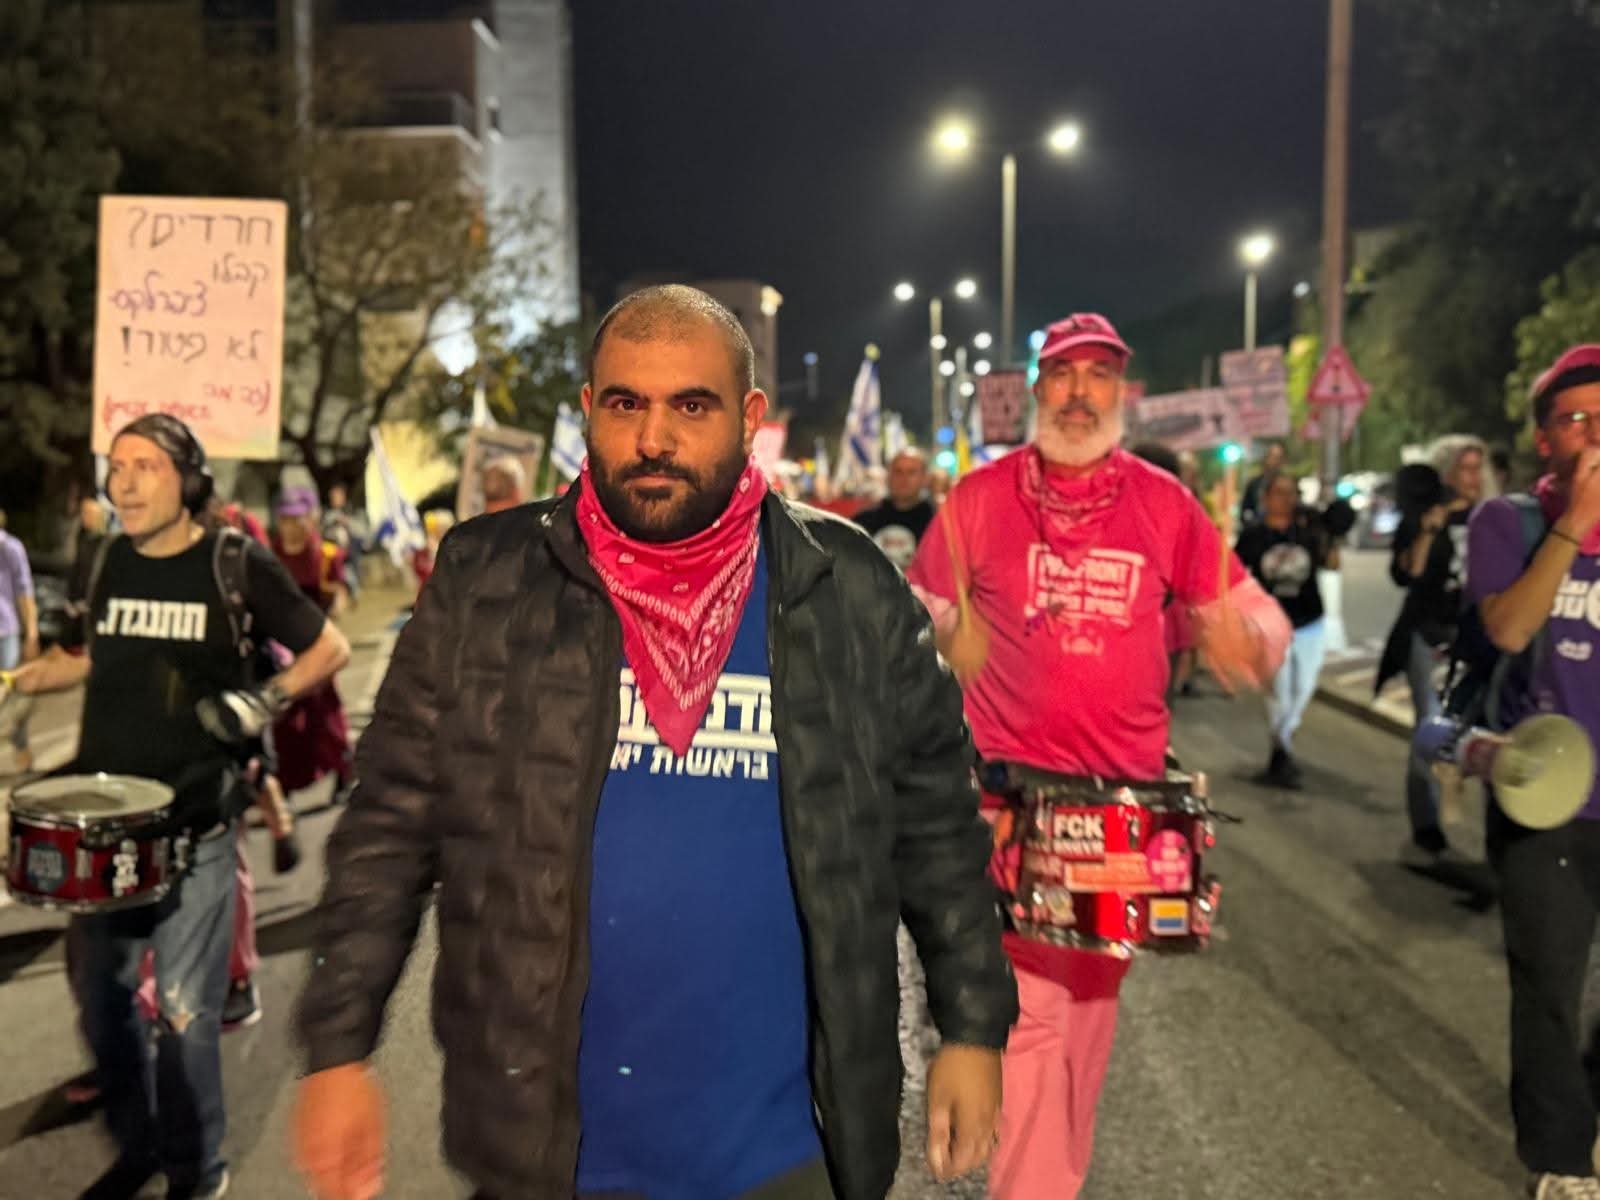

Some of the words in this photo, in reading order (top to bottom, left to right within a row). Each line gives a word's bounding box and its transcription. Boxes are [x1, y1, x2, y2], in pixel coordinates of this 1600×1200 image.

[128, 206, 273, 249] חרדים?
[213, 252, 270, 298] קבלו
[226, 328, 263, 361] לא
[650, 746, 769, 780] בראשות
[1053, 813, 1105, 838] FCK
